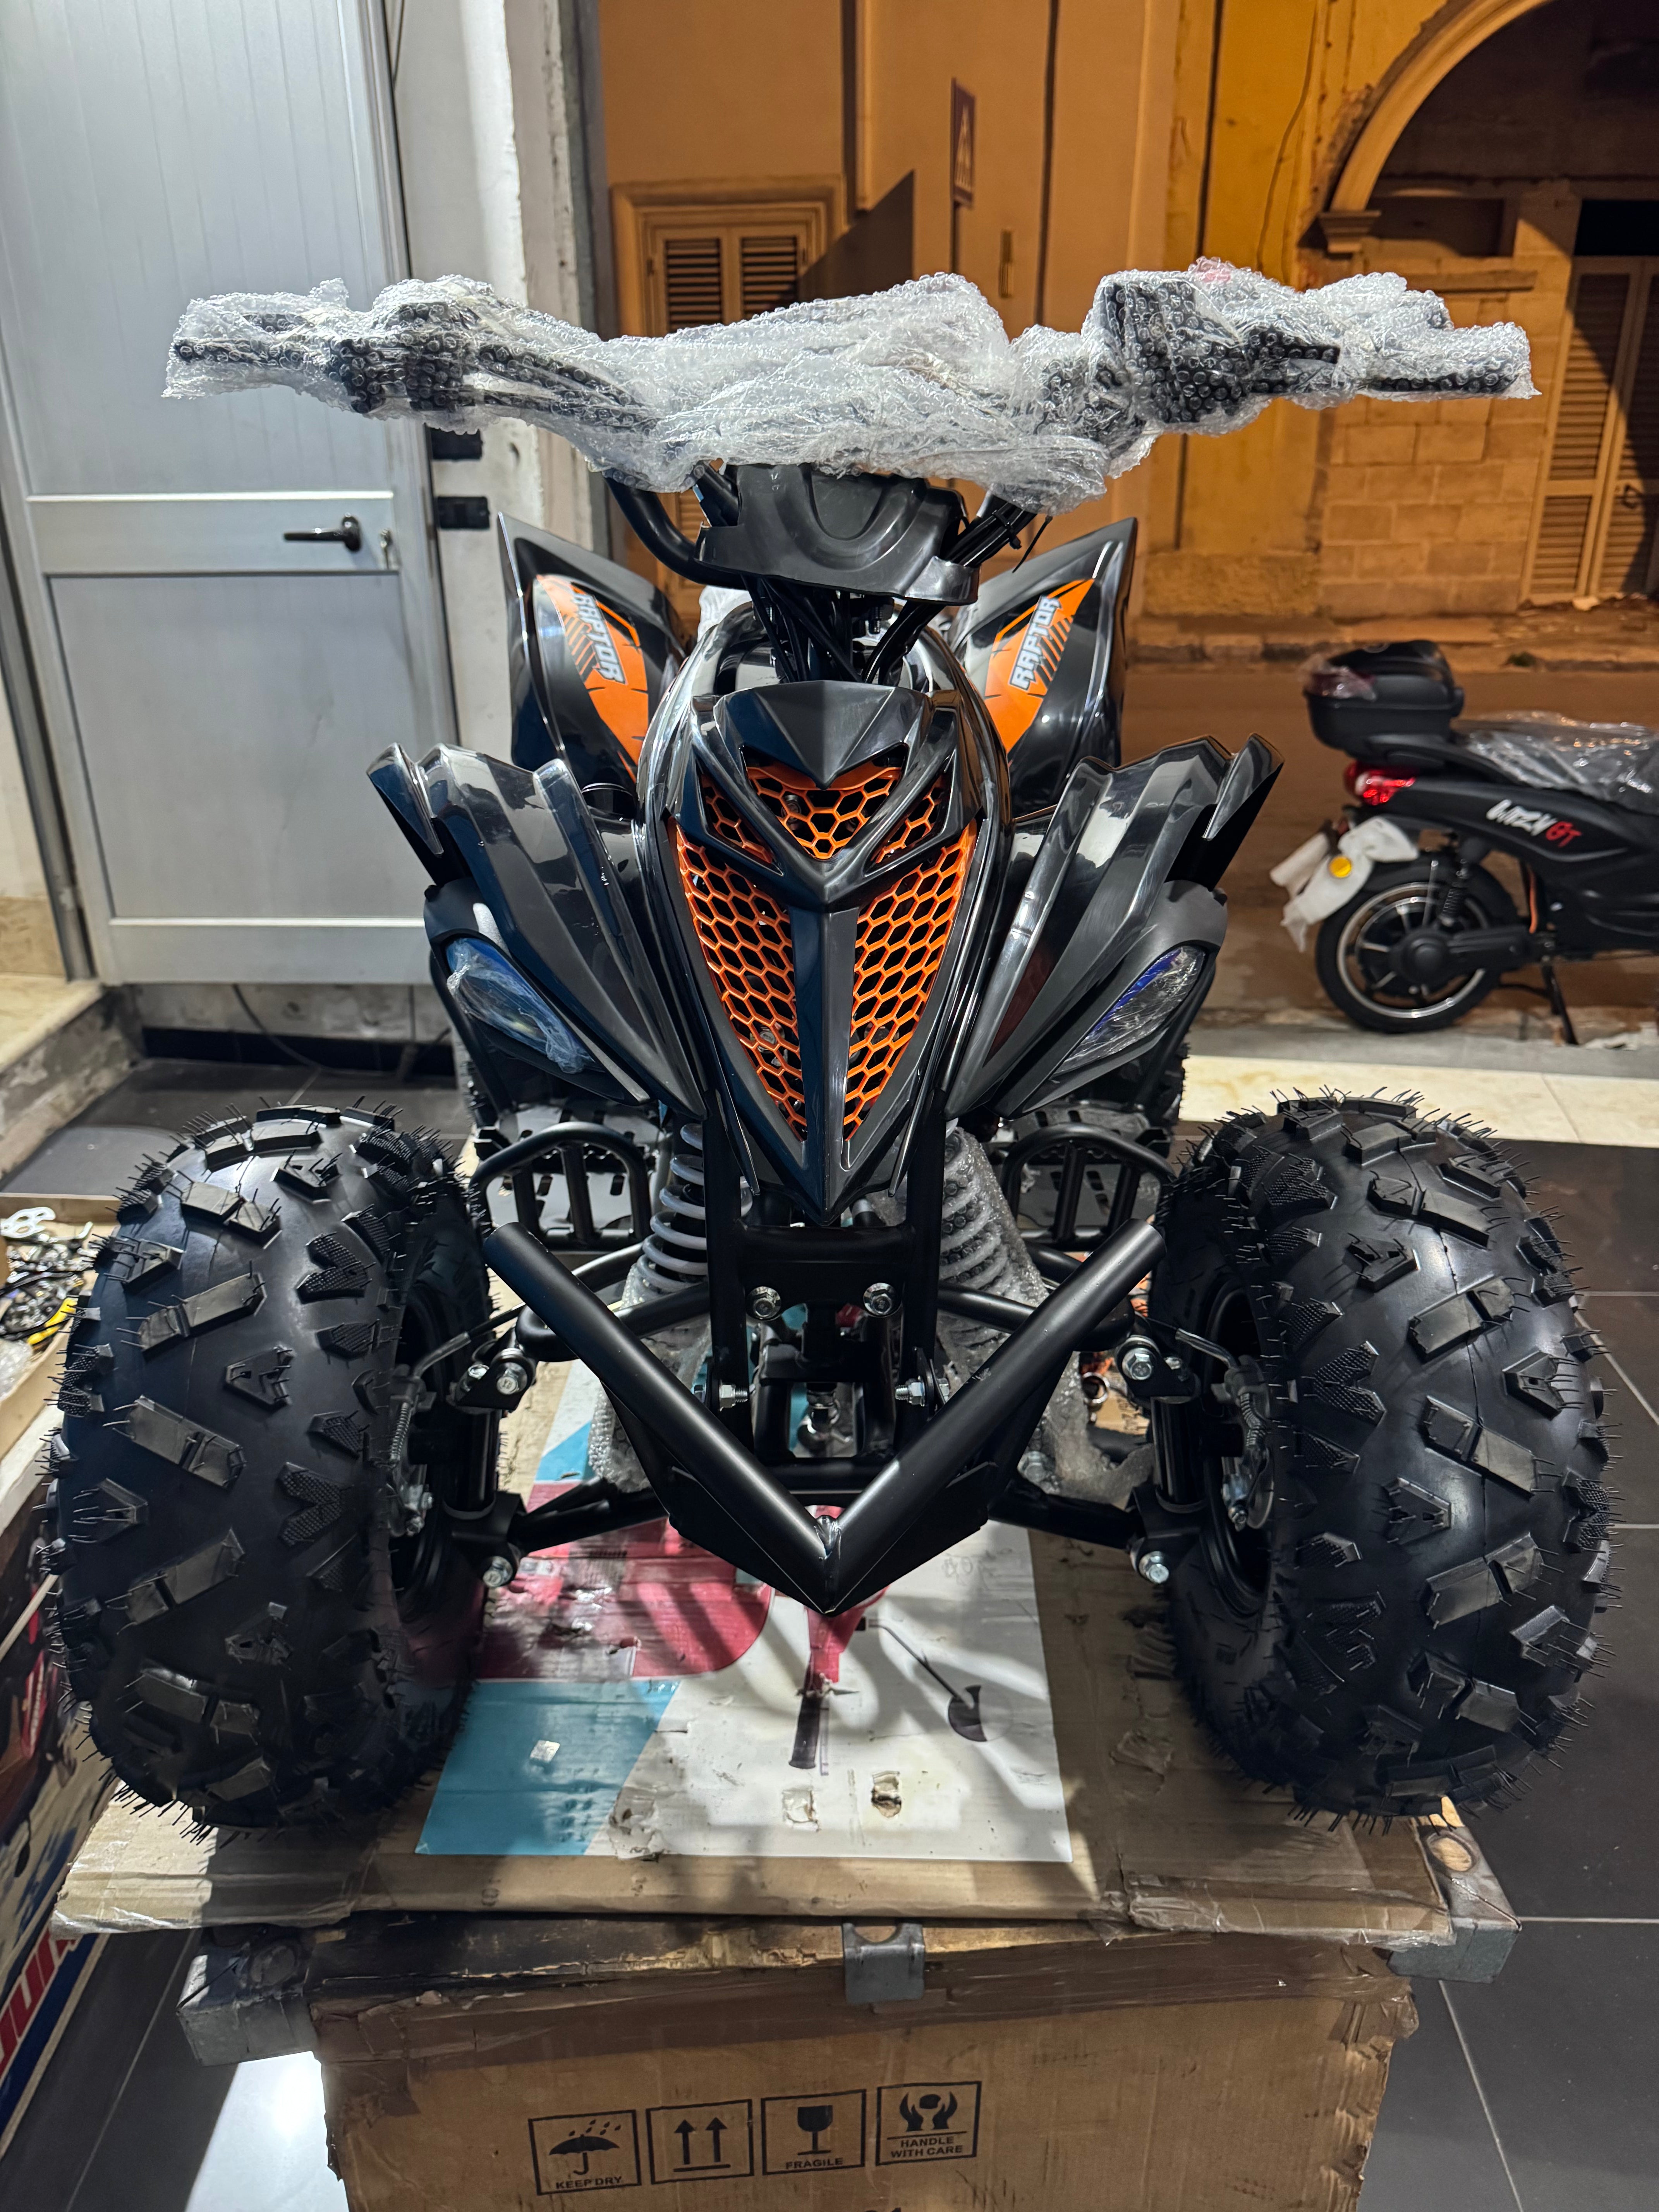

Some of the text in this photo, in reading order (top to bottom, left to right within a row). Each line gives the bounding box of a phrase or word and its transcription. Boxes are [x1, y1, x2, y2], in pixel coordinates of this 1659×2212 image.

[572, 593, 625, 684] RAPTOR
[1010, 595, 1061, 691] RAPTOR
[900, 2136, 954, 2148] HANDLE
[891, 2145, 963, 2158] WITH CARE
[785, 2157, 843, 2169] FRAGILE
[556, 2176, 622, 2189] KEEP DRY
